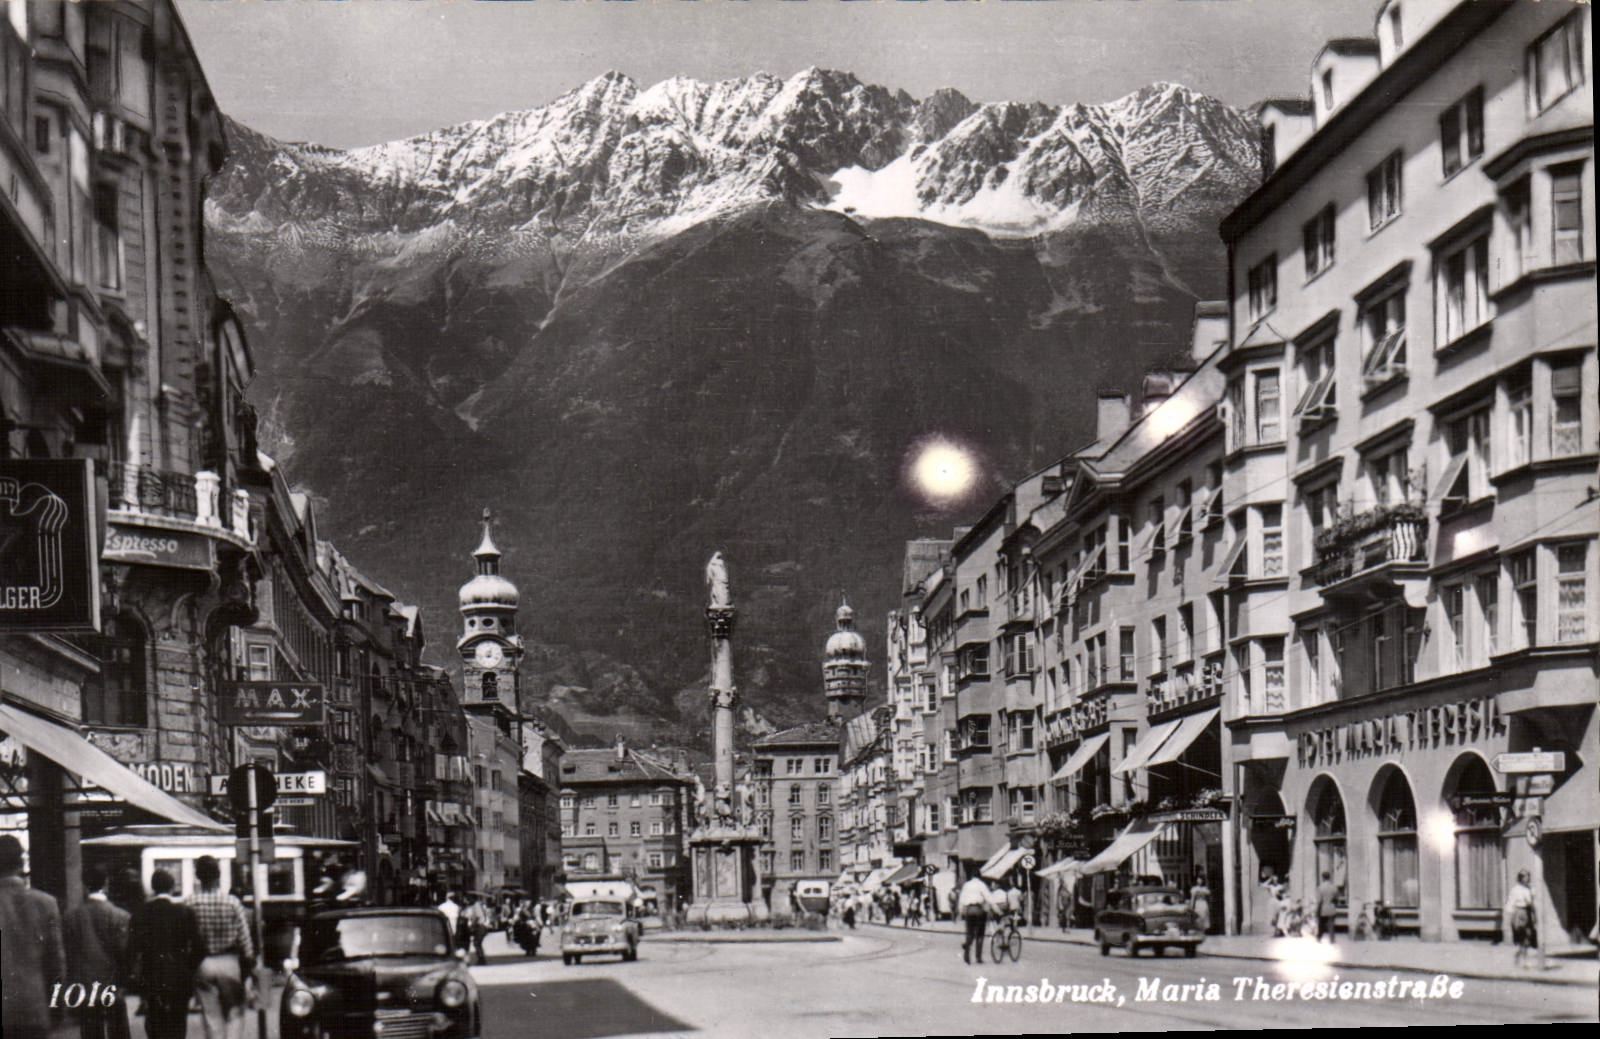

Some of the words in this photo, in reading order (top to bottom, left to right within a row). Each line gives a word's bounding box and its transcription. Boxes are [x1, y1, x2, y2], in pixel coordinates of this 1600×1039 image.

[233, 686, 311, 709] MAX
[1297, 725, 1342, 768] HOTEL
[1345, 713, 1402, 760] MARIA
[1406, 696, 1508, 752] THERESIA
